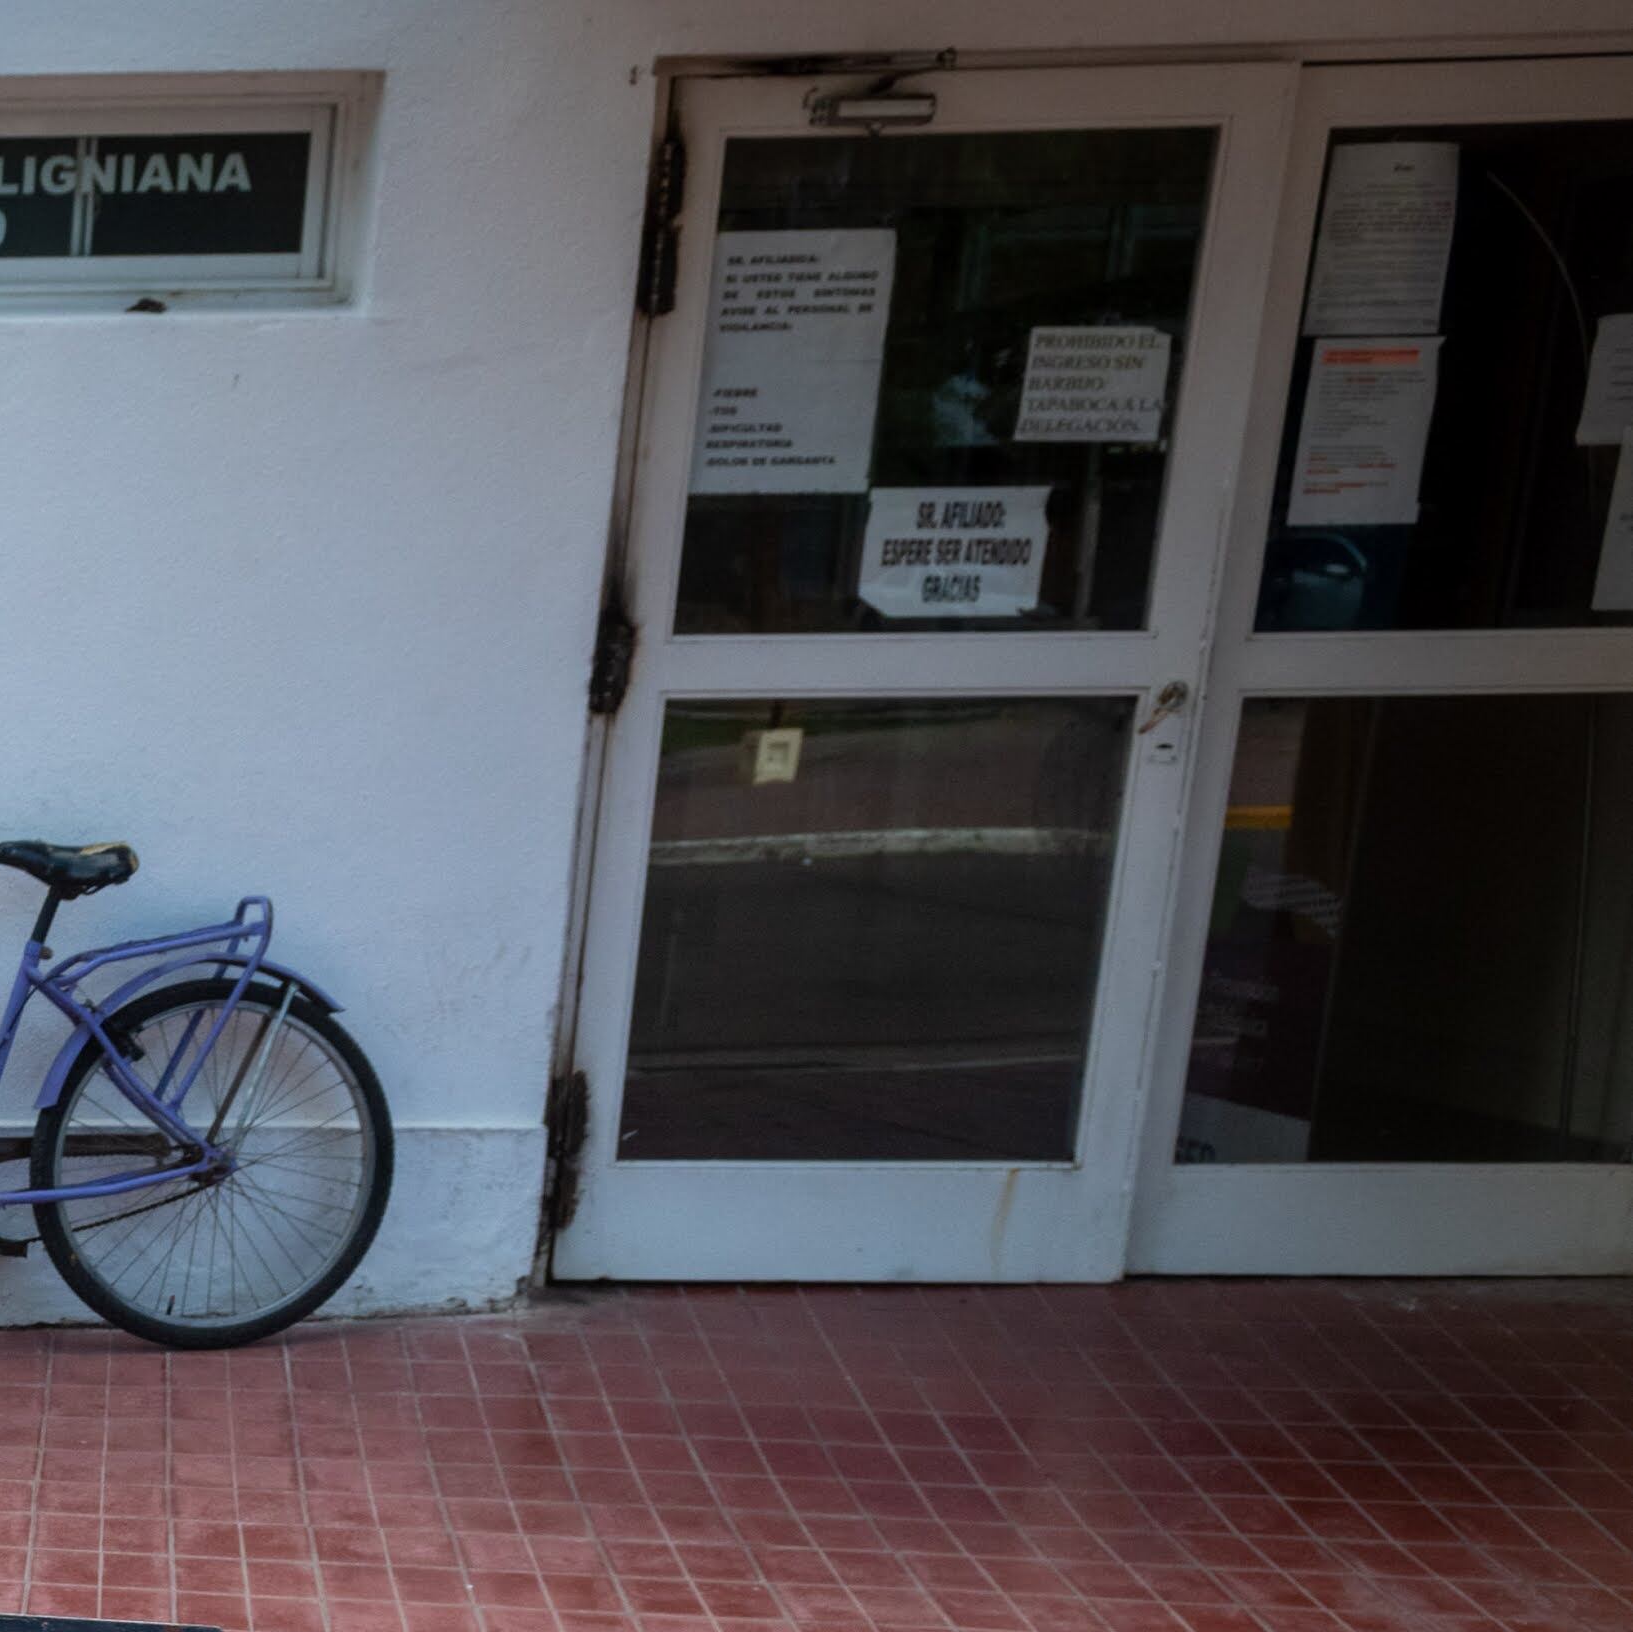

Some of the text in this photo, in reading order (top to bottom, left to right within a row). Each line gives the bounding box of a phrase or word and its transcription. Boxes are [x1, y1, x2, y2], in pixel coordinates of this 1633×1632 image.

[1035, 334, 1160, 349] PROHIBIDO EL
[1032, 355, 1145, 369] INGRESO SIN
[916, 501, 1006, 529] SR. AFILIADO:
[881, 537, 1032, 566] ESPERE SER ATENDIDO
[922, 575, 981, 604] GRACIAS
